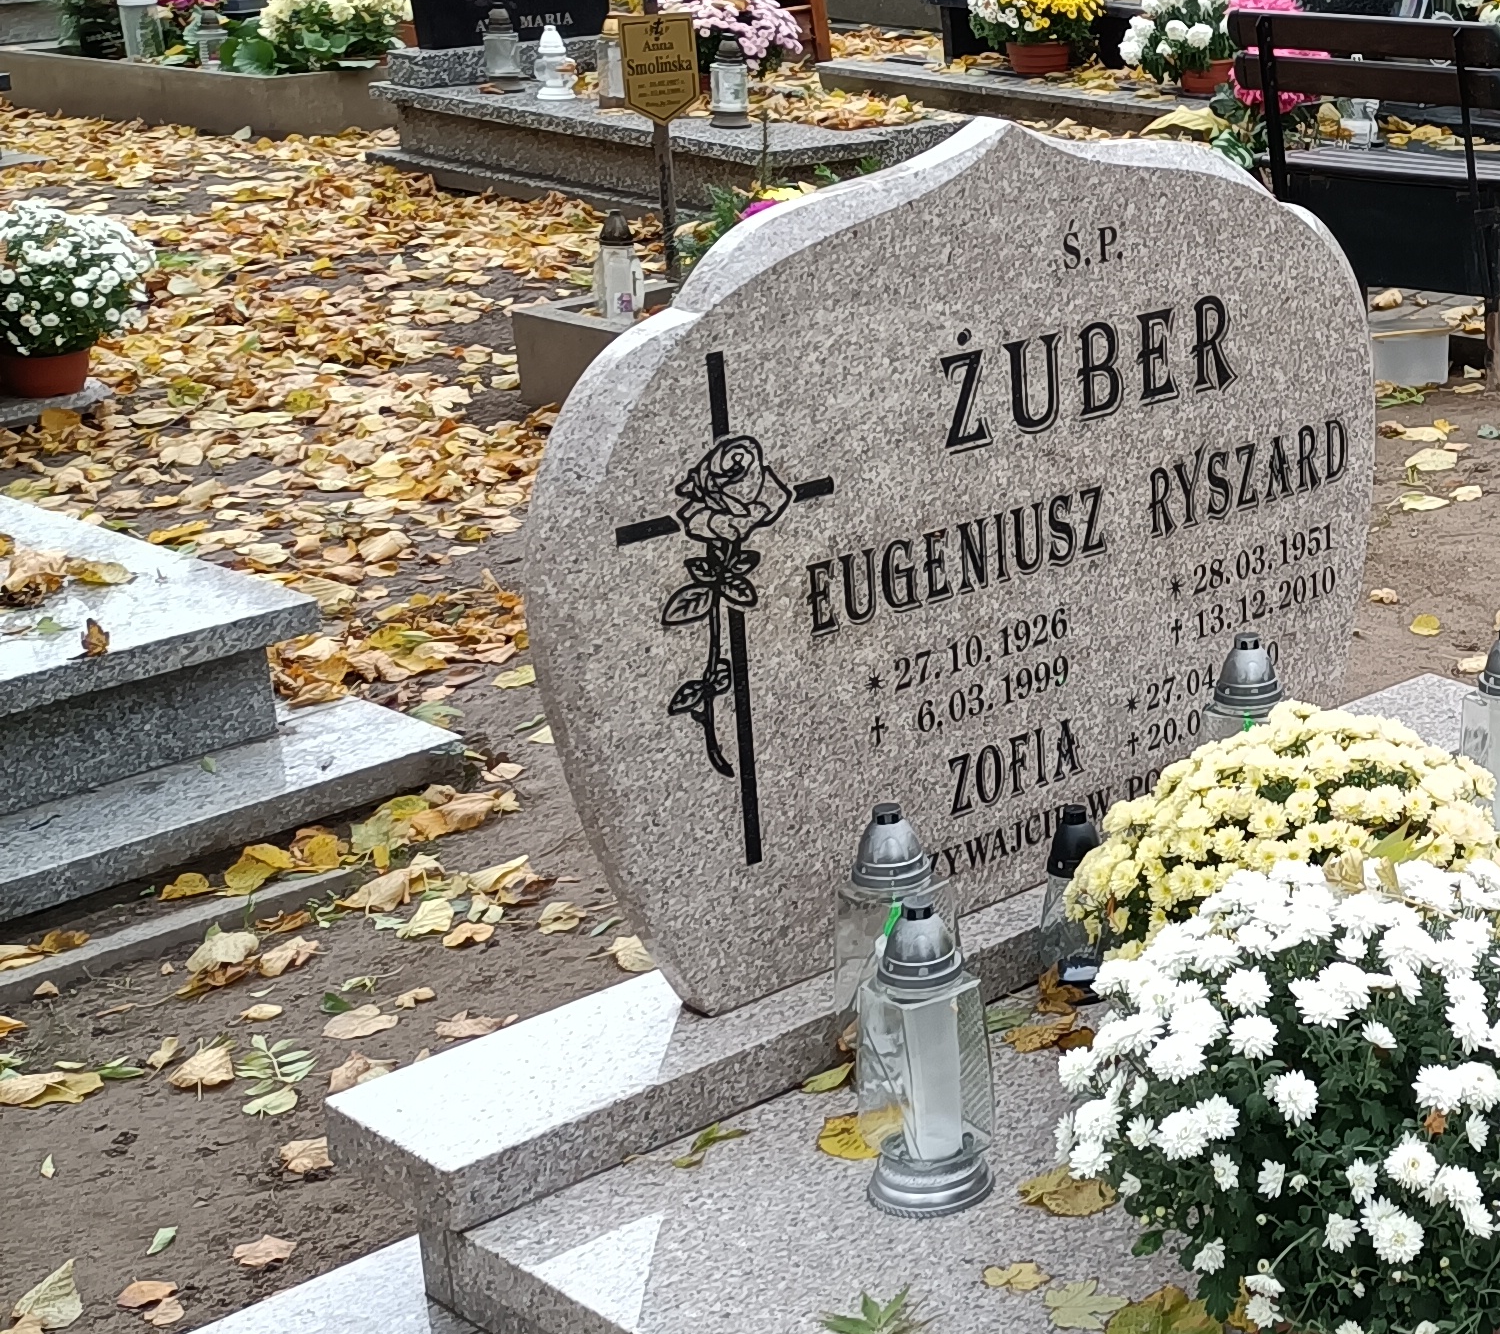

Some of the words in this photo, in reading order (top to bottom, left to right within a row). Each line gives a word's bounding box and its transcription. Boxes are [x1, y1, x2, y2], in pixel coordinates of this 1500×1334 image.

[520, 12, 574, 29] MARIA
[627, 54, 693, 77] Smolińska
[642, 40, 675, 53] Anna
[938, 294, 1238, 455] ŻUBER
[805, 486, 1107, 638] EUGENIUSZ
[1147, 418, 1349, 539] RYSZARD
[893, 607, 1069, 695] 27.10.1926
[1192, 521, 1334, 597] 28.03.1951
[917, 654, 1069, 735] 6.03.1999
[1196, 565, 1336, 640] 13.12.2010
[948, 718, 1085, 819] ZOFIA
